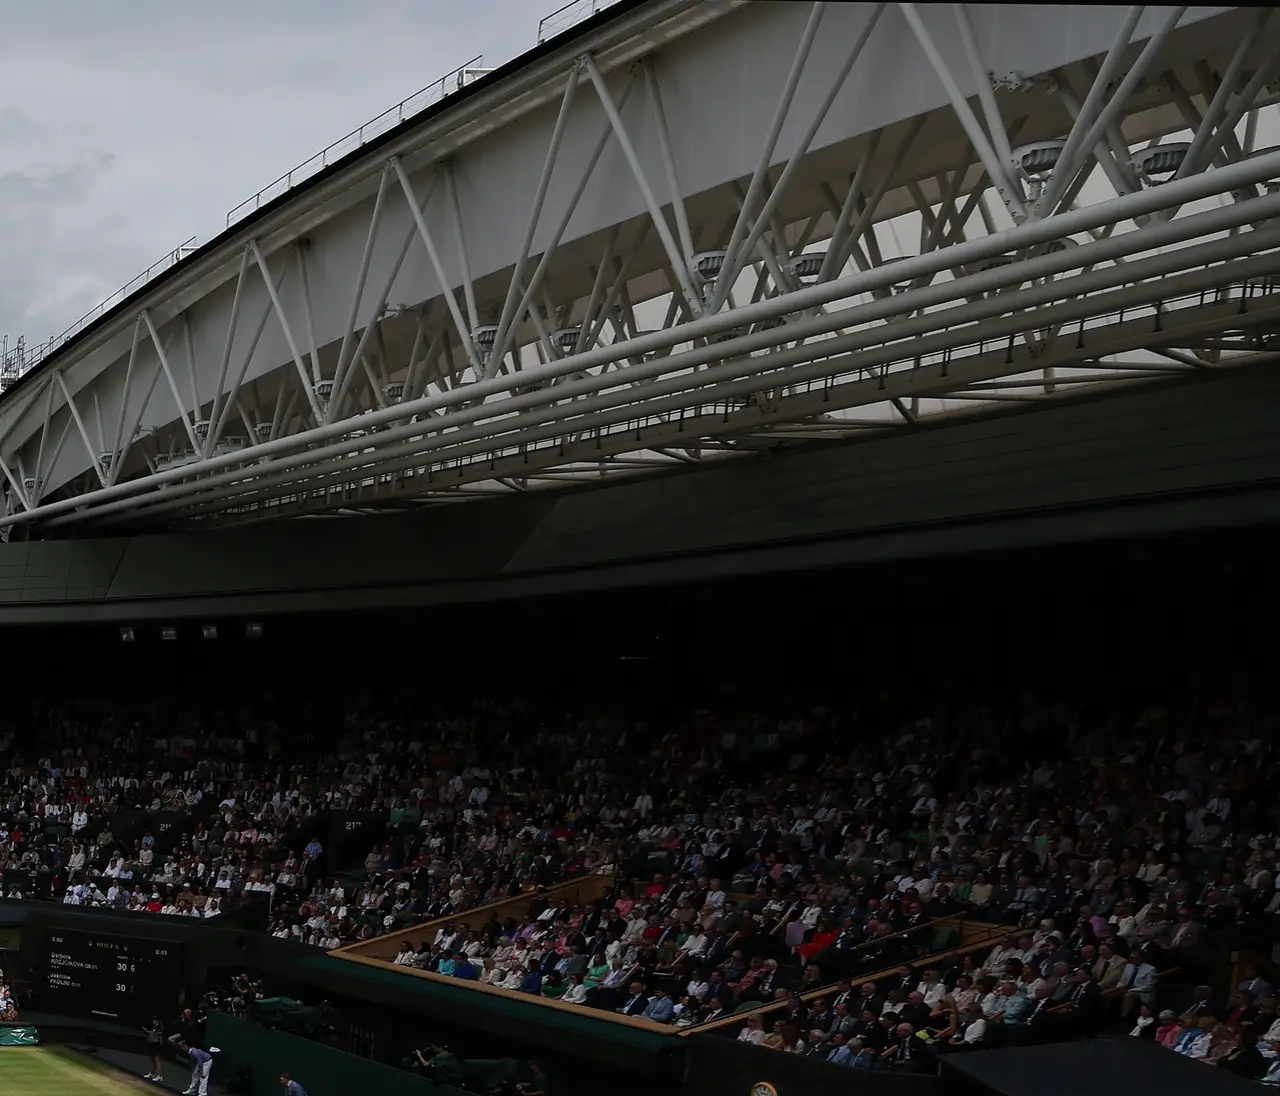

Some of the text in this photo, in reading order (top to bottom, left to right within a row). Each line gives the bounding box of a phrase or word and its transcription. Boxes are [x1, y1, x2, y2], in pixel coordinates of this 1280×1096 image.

[116, 962, 136, 972] 30 6
[115, 983, 126, 992] 30
